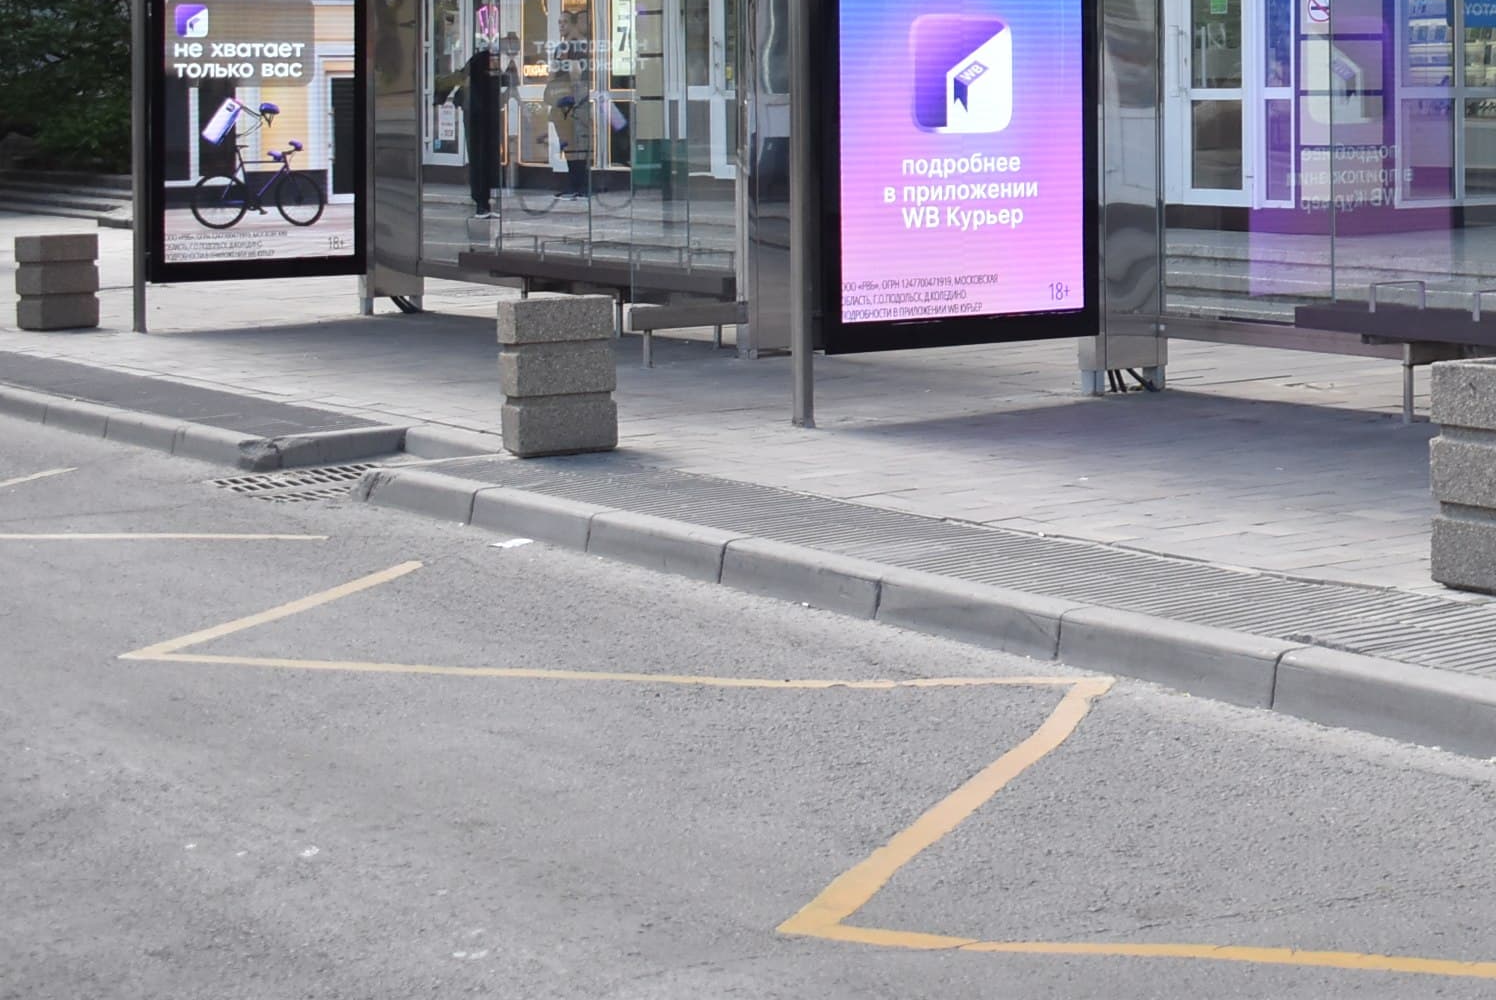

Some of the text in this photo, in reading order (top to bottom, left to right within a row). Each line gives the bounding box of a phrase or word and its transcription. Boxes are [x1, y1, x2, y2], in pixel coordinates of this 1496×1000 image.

[173, 42, 306, 58] не хватает
[173, 62, 303, 79] только вас
[959, 64, 984, 80] WB
[902, 153, 1022, 179] подробнее
[883, 181, 1039, 206] в приложении
[902, 205, 1024, 232] WB Курьер
[328, 236, 345, 251] 18+
[1048, 282, 1071, 301] 18+
